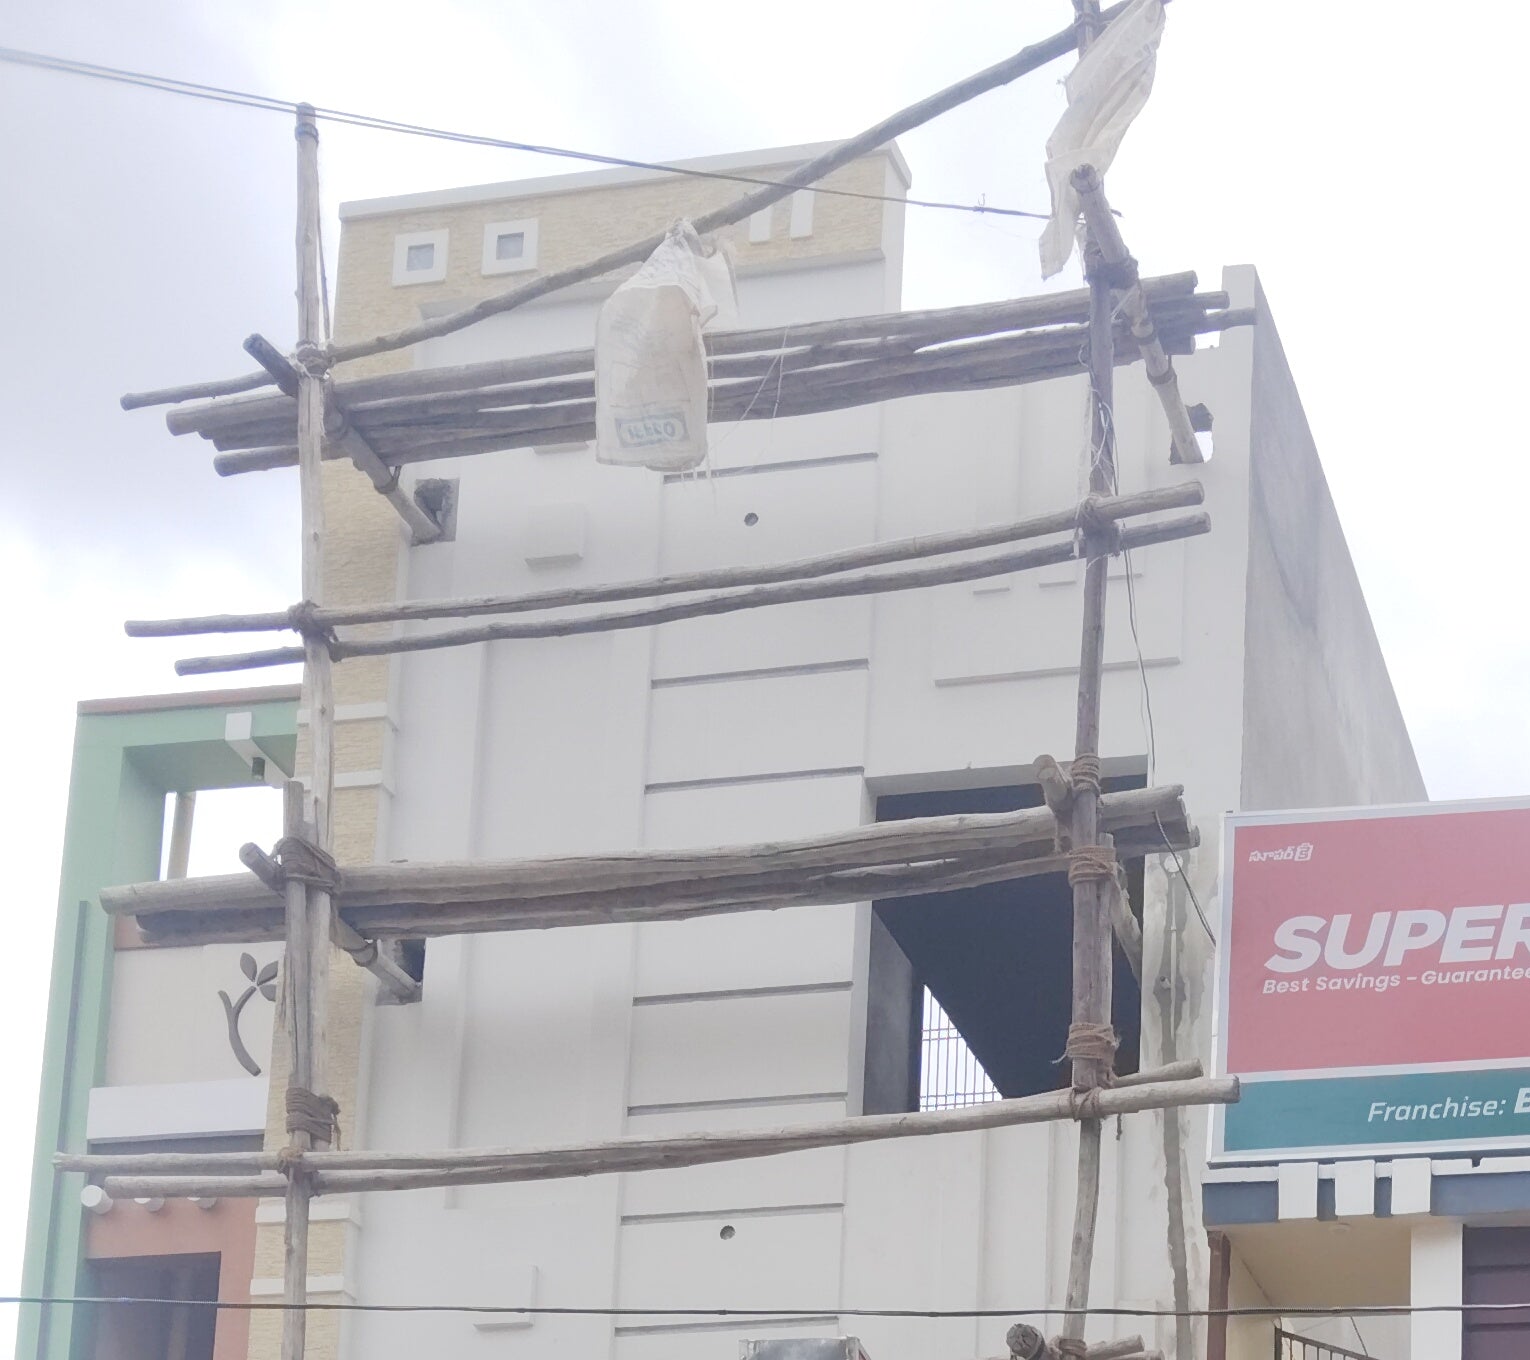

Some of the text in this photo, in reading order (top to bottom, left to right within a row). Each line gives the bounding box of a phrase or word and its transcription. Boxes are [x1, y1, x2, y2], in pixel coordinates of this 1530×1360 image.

[1262, 974, 1310, 994] Best
[1316, 972, 1400, 993] Savings
[1367, 1097, 1507, 1123] Franchise:
